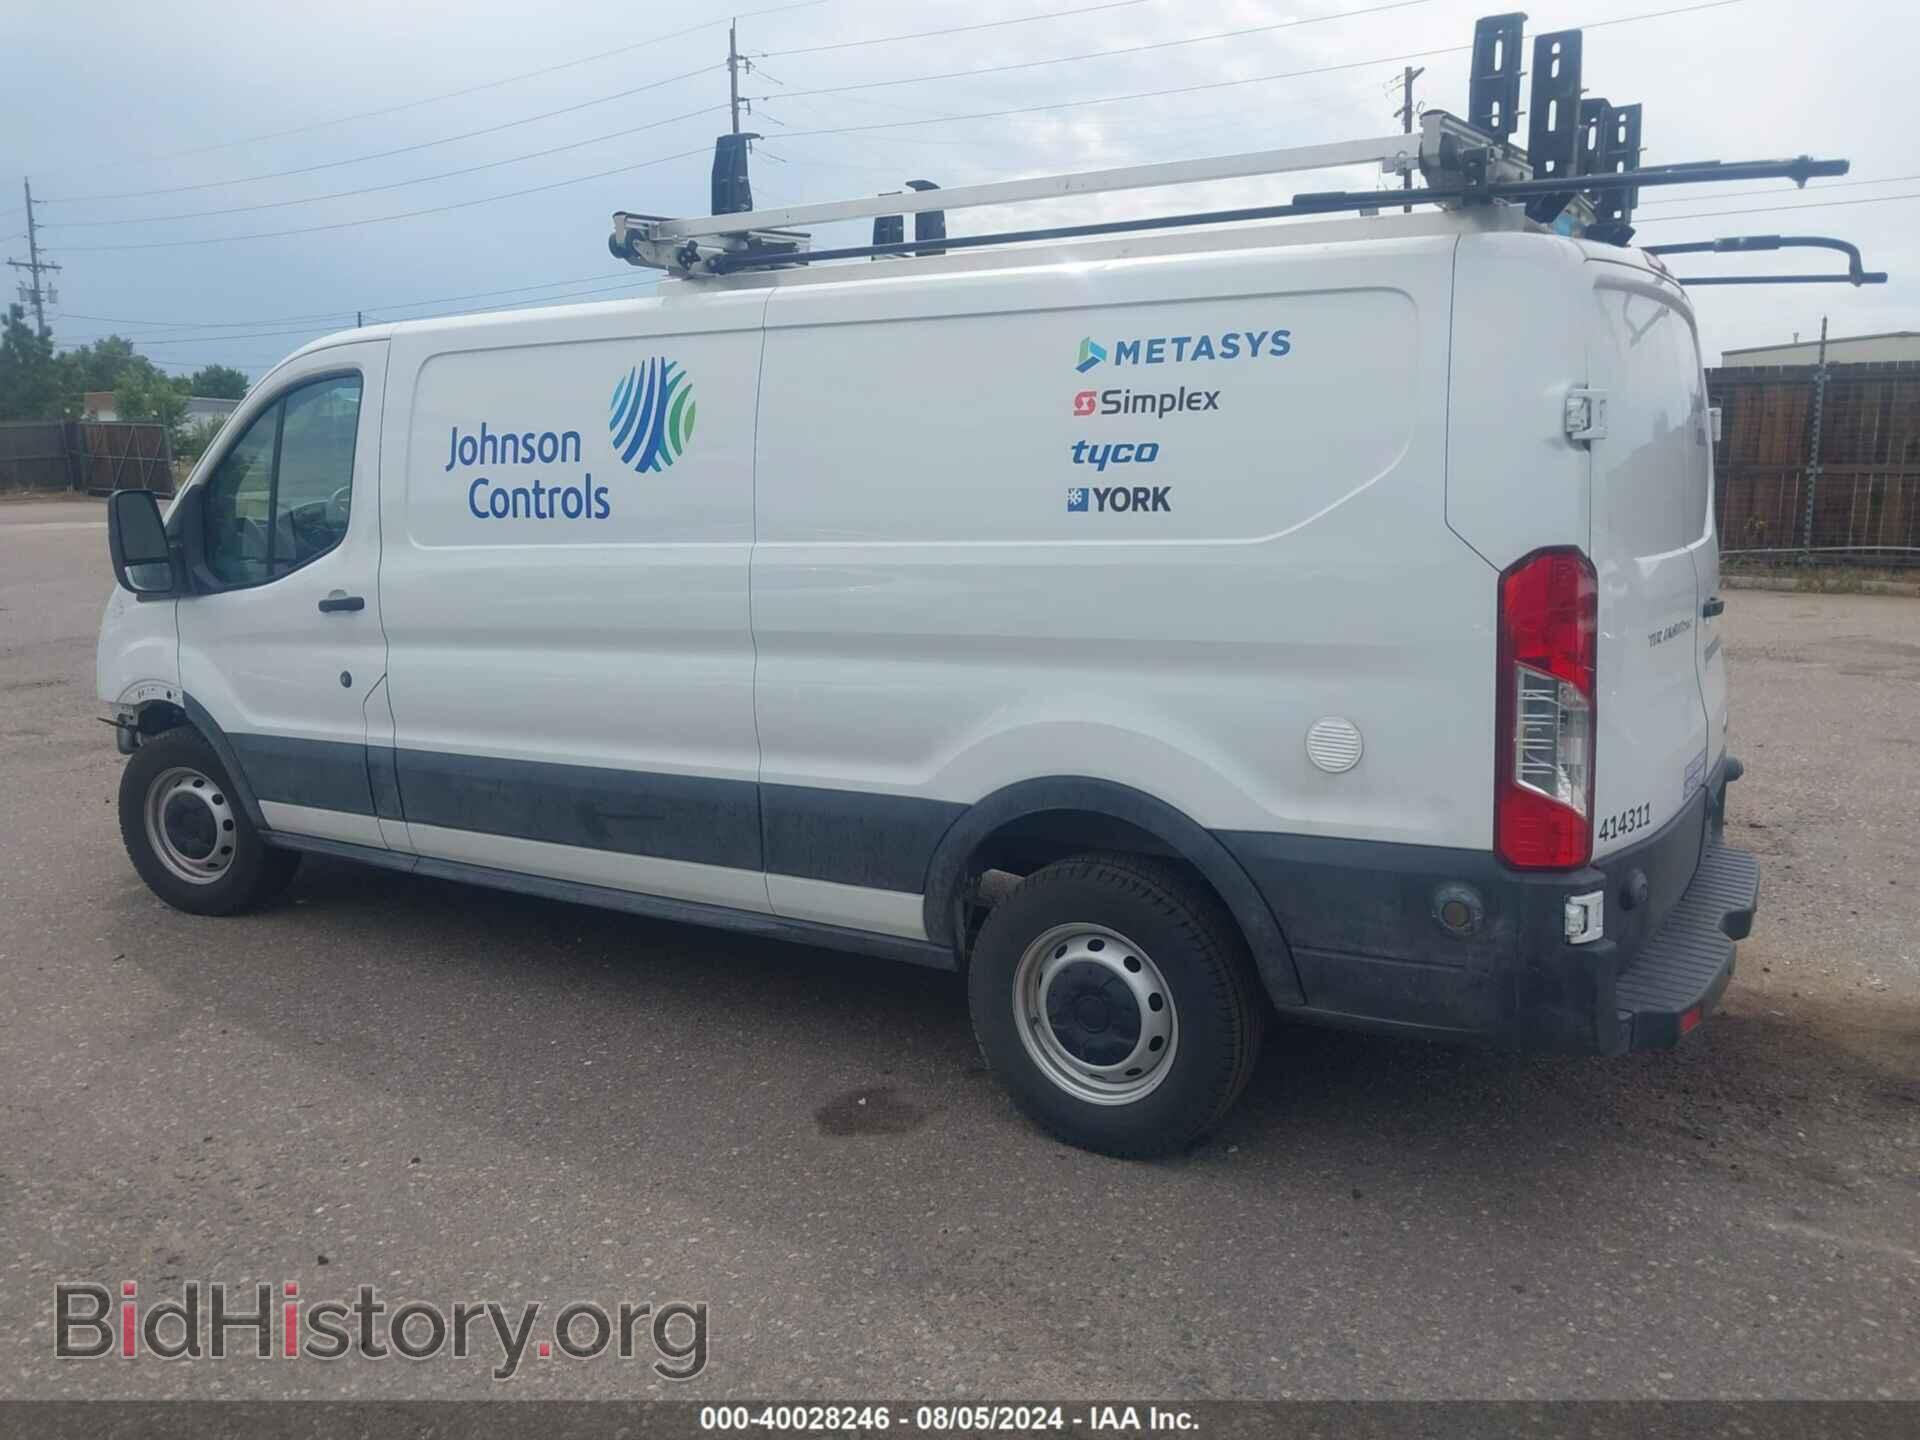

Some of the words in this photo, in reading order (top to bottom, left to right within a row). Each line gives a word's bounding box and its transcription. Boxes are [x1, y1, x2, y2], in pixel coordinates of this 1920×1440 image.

[1114, 329, 1292, 366] METASYS
[1101, 386, 1221, 419] Simplex
[445, 421, 581, 472] Johnson
[1071, 440, 1160, 472] tyco
[468, 473, 611, 519] Controls
[1093, 486, 1172, 512] YORK
[1598, 801, 1651, 842] 414311
